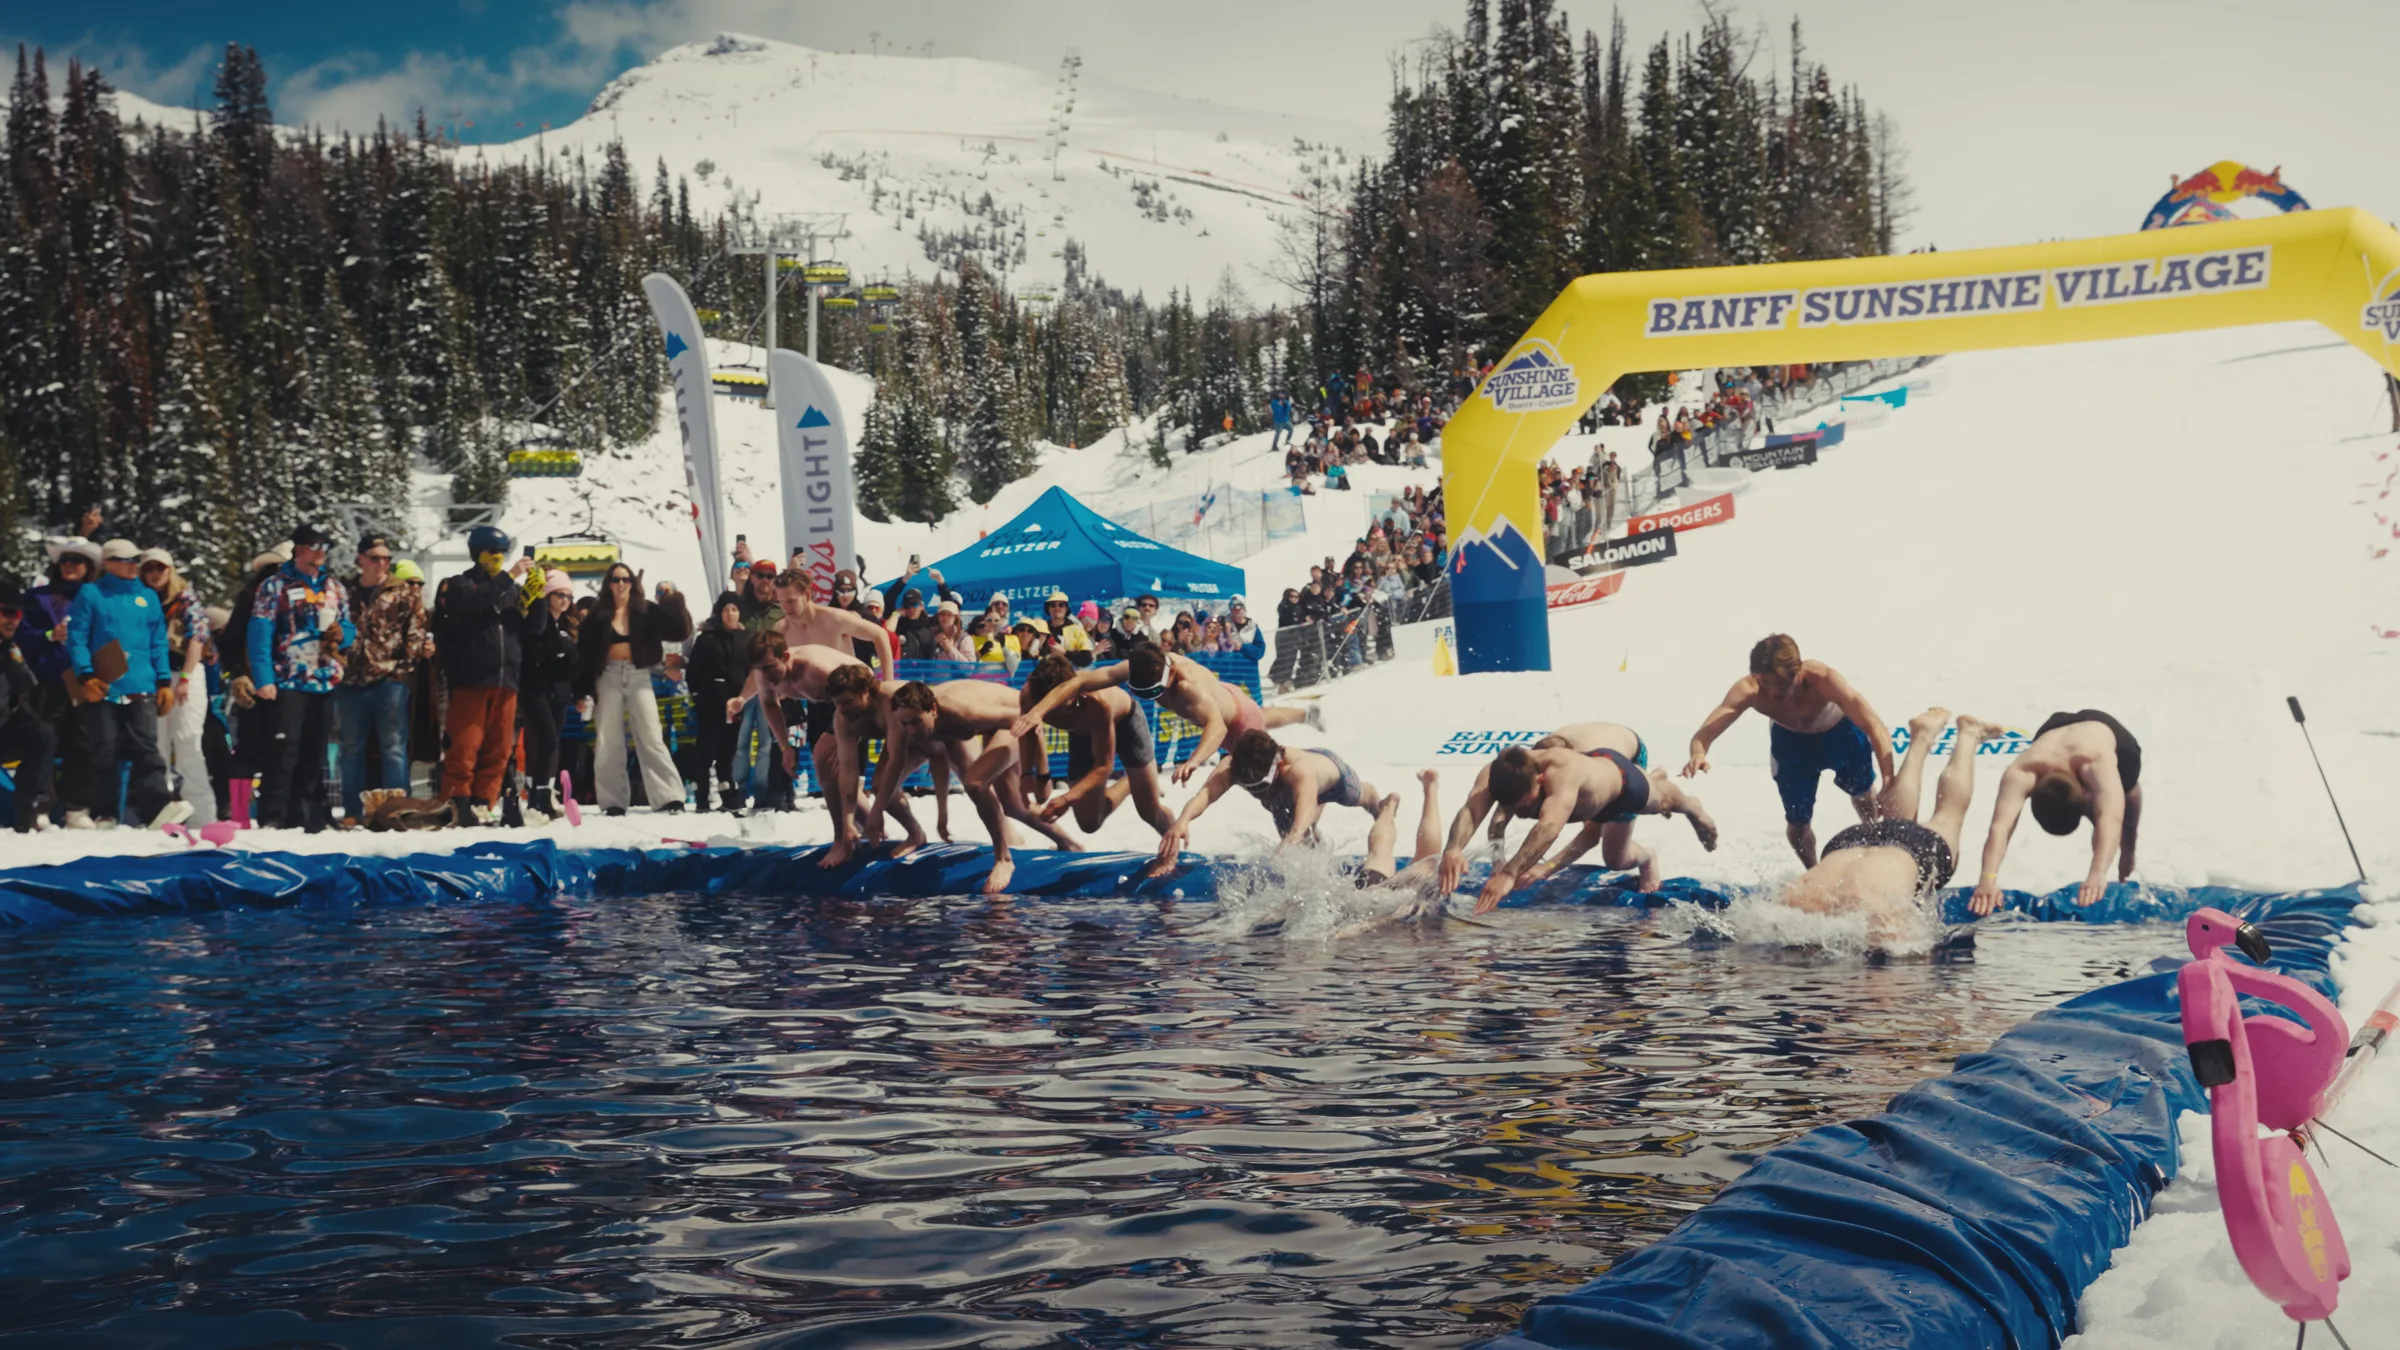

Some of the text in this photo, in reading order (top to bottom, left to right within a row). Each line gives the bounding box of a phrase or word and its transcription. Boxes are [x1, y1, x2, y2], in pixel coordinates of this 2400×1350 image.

[1650, 250, 2266, 333] BANFF SUNSHINE VILLAGE
[1483, 368, 1570, 395] SUNSHINE
[1494, 382, 1576, 407] VILLAGE
[1742, 445, 1805, 463] MOUNTAIN
[803, 434, 834, 534] LIGHT
[1659, 502, 1723, 529] ROGERS
[979, 540, 1062, 558] SELTZER
[1568, 536, 1667, 571] SALOMON
[998, 584, 1062, 601] SELTZER
[1448, 730, 1557, 742] BANF
